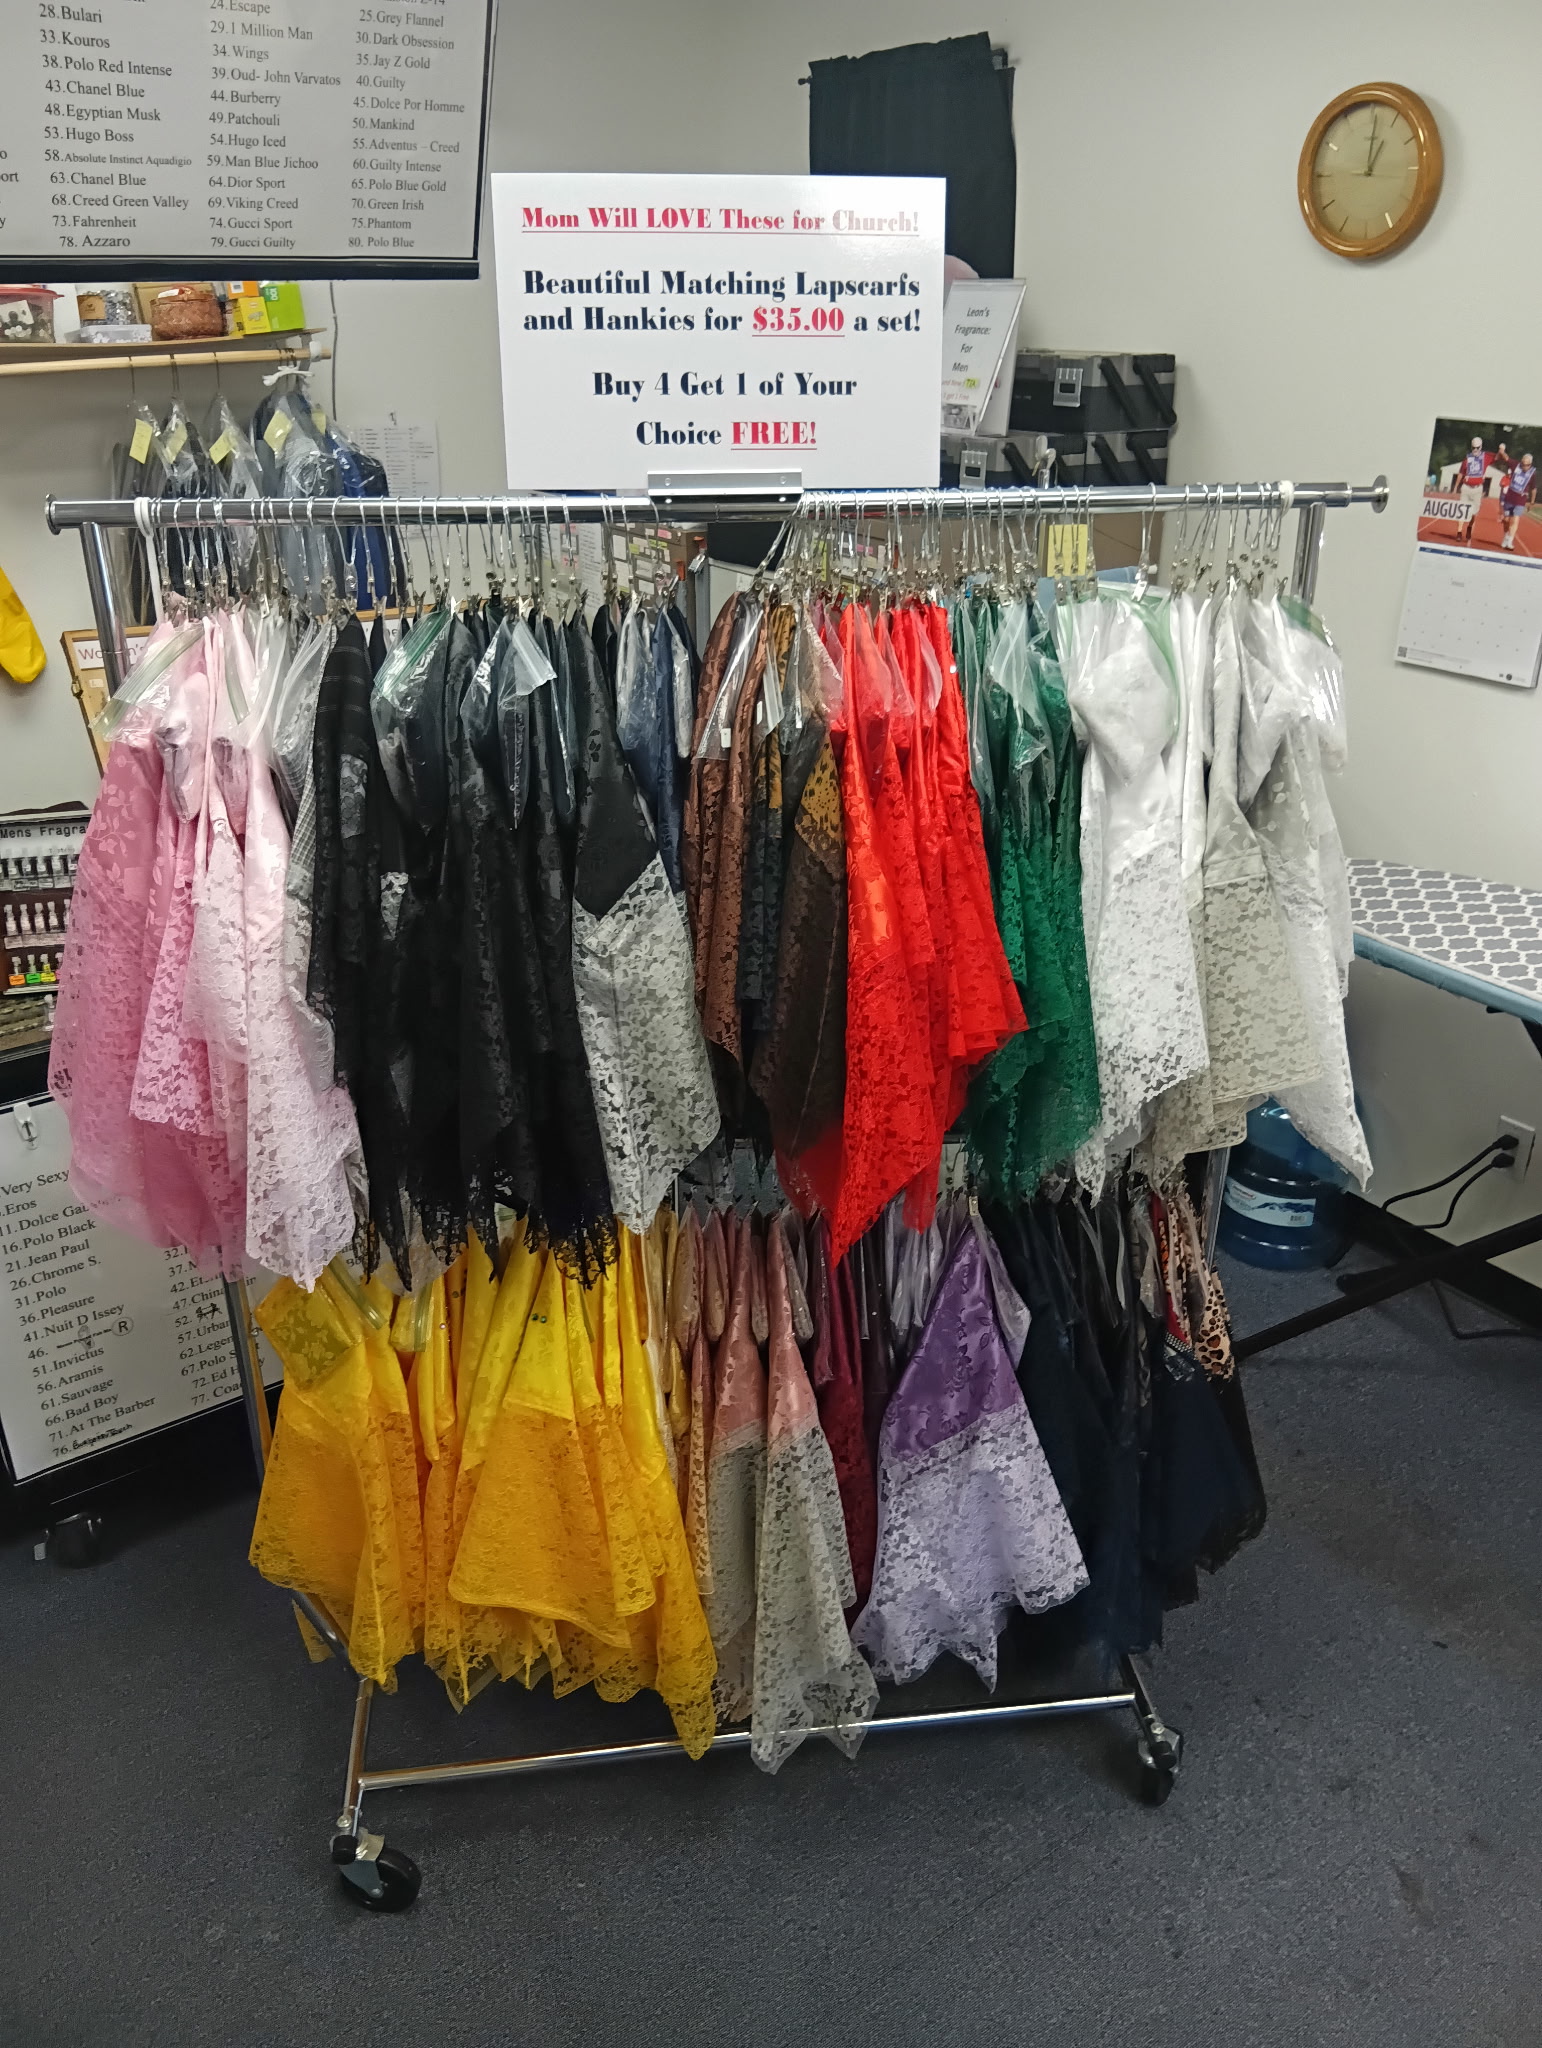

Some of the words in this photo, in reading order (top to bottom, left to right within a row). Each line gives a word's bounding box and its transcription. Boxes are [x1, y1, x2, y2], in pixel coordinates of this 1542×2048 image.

[406, 12, 443, 27] Flannel
[241, 22, 284, 38] Million
[288, 27, 313, 40] Man
[401, 34, 454, 50] Obsession
[98, 59, 124, 73] Red
[128, 61, 173, 76] Intense
[393, 56, 402, 67] Z
[405, 56, 430, 69] Gold
[264, 70, 291, 83] John
[294, 72, 341, 86] Varvatos
[116, 84, 145, 97] Blue
[404, 98, 422, 111] Por
[424, 100, 465, 113] Homme
[127, 107, 160, 121] Musk
[104, 129, 135, 142] Boss
[263, 135, 286, 147] Iced
[430, 141, 460, 153] Creed
[109, 154, 144, 165] Instinct
[145, 155, 192, 167] Aquadigio
[255, 156, 280, 168] Blue
[405, 160, 441, 172] Intense
[118, 174, 146, 186] Blue
[256, 177, 286, 191] Sport
[395, 180, 419, 191] Blue
[421, 180, 446, 191] Gold
[112, 195, 149, 207] Green
[152, 196, 189, 210] Valley
[266, 197, 299, 209] Creed
[402, 199, 424, 210] Irish
[263, 218, 293, 231] Sport
[521, 206, 580, 228] Mom
[588, 206, 638, 229] Will
[647, 207, 711, 229] LOVE
[719, 207, 785, 230] These
[792, 209, 825, 231] for
[832, 209, 919, 233] Church!
[59, 236, 78, 247] 78.
[82, 235, 131, 247] Azzaro
[263, 237, 296, 250] Guilty
[348, 237, 364, 247] 80.
[367, 237, 390, 247] Polo
[392, 237, 415, 247] Blue
[523, 269, 650, 296] Beautiful
[660, 271, 786, 302] Matching
[794, 271, 920, 302] Lapscarfs
[967, 307, 990, 317] Leon's
[523, 306, 574, 331] and
[583, 306, 695, 331] Hankies
[704, 306, 743, 331] for
[752, 306, 845, 334] $35.00
[853, 315, 869, 331] a
[877, 308, 921, 332] set!
[954, 324, 991, 336] Fragrance:
[960, 344, 973, 353] For
[952, 363, 968, 372] Men
[592, 371, 645, 402] Buy
[654, 372, 670, 396] 4
[680, 371, 724, 396] Get
[737, 372, 747, 396] 1
[759, 371, 784, 396] of
[794, 371, 857, 397] Your
[636, 420, 722, 446] Choice
[730, 421, 817, 447] FREE!
[1423, 500, 1472, 520] AUGUST
[0, 828, 31, 838] Mens
[40, 825, 88, 837] Fragra
[36, 1169, 70, 1187] Sexy
[57, 1218, 97, 1239] Black
[60, 1238, 90, 1256] Paul
[87, 1255, 102, 1267] S.
[77, 1314, 89, 1326] D
[92, 1304, 125, 1321] Issey
[174, 1316, 193, 1328] 52.
[27, 1347, 49, 1360] 46.
[94, 1393, 119, 1409] Boy
[191, 1394, 210, 1406] 77.
[87, 1412, 112, 1427] The
[115, 1397, 156, 1418] Barber
[52, 1445, 72, 1458] 76.
